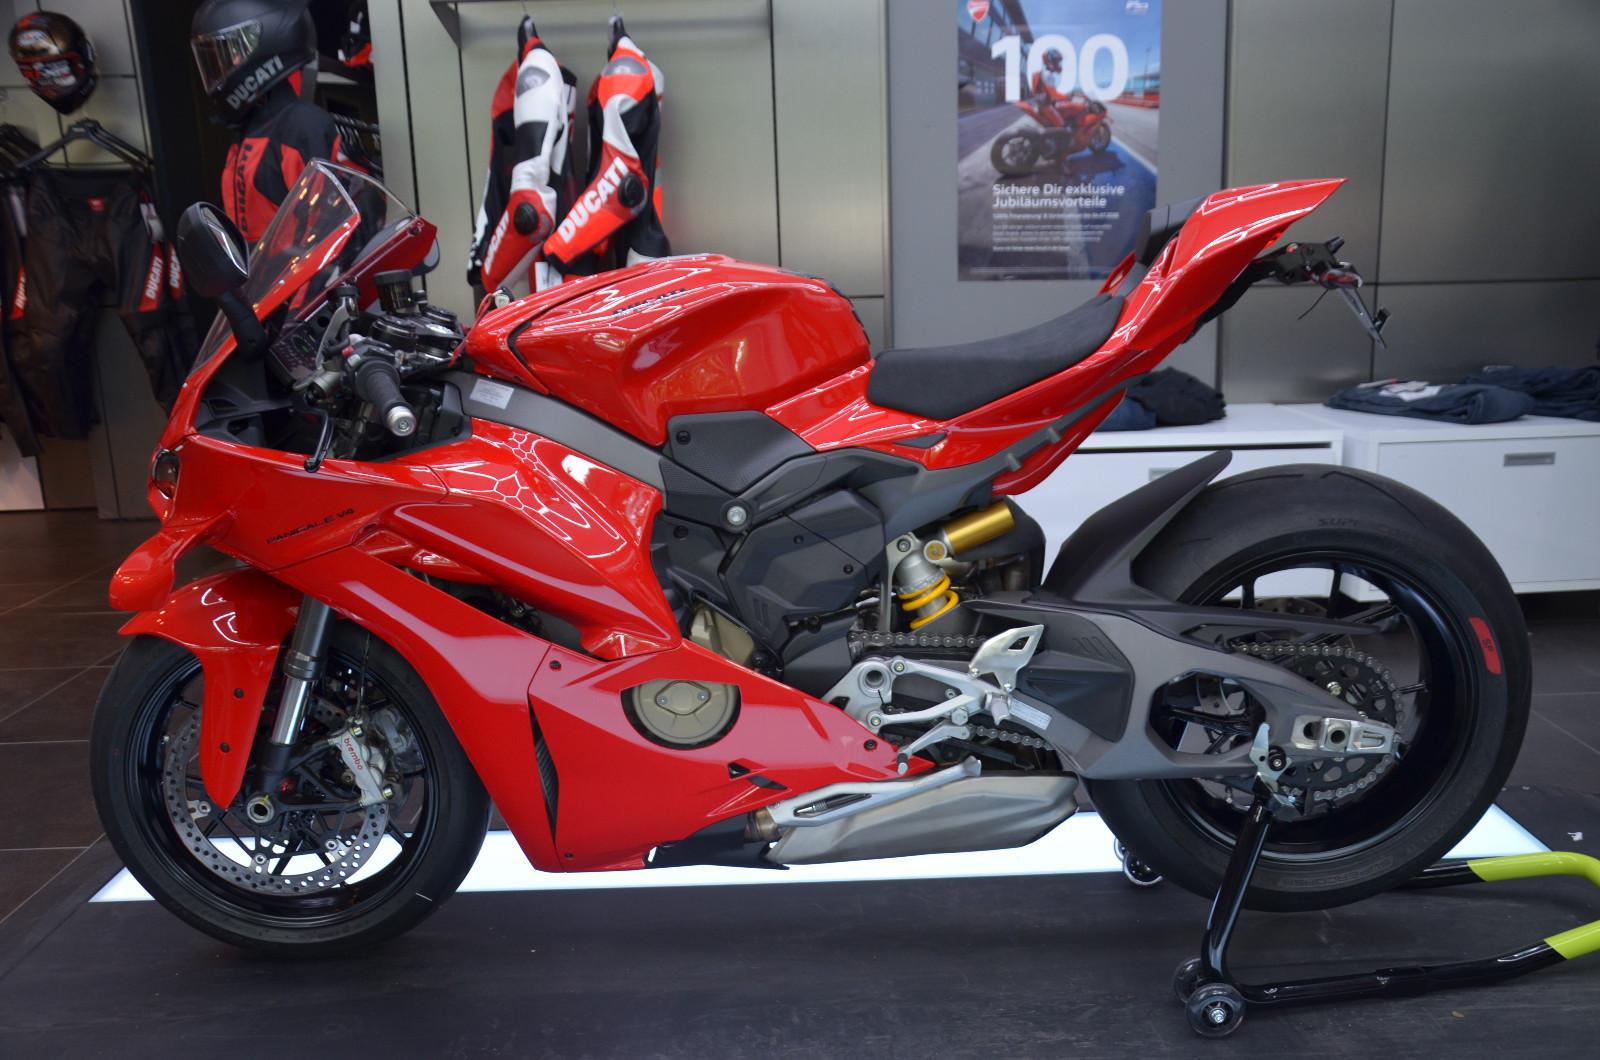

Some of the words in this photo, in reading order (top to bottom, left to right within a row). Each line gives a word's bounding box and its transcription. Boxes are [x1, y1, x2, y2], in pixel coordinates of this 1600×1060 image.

[226, 55, 285, 110] DUCATI
[991, 33, 1129, 103] 100
[557, 157, 629, 243] DUCATI
[992, 184, 1040, 195] Sichere
[1043, 184, 1062, 195] Dir
[1065, 183, 1125, 195] exklusive
[992, 196, 1107, 208] Jubiläumsvorteile
[484, 210, 509, 275] DUCATI
[145, 256, 164, 300] DUCATI
[169, 248, 181, 289] DUCA
[344, 737, 364, 771] brembo
